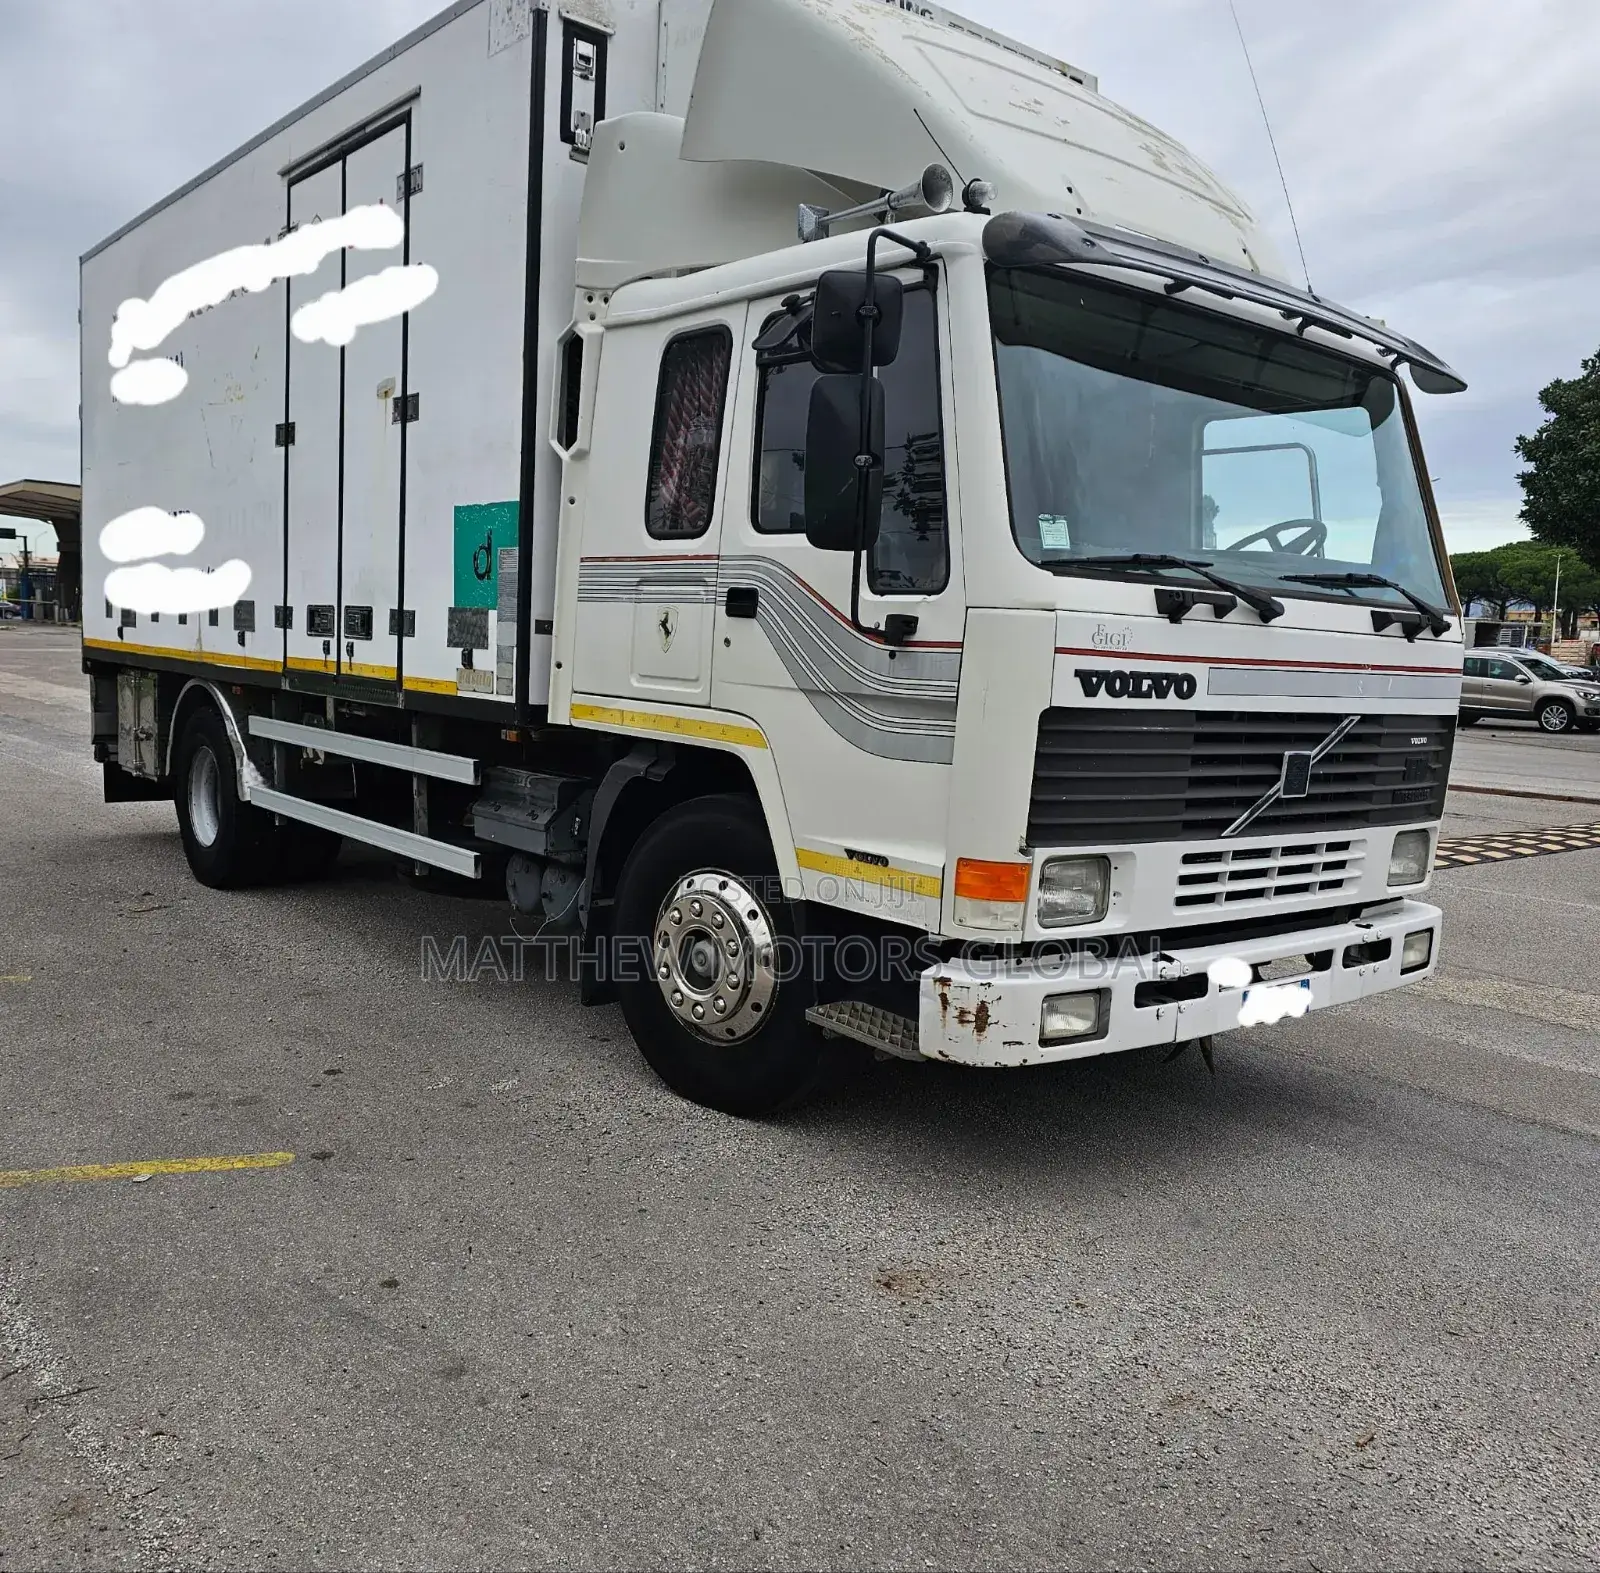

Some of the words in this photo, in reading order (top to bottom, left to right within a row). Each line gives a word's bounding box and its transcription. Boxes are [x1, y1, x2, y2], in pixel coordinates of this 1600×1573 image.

[1073, 668, 1198, 700] VOLVO
[1410, 736, 1428, 745] VOLVO
[843, 847, 890, 868] VOLVO
